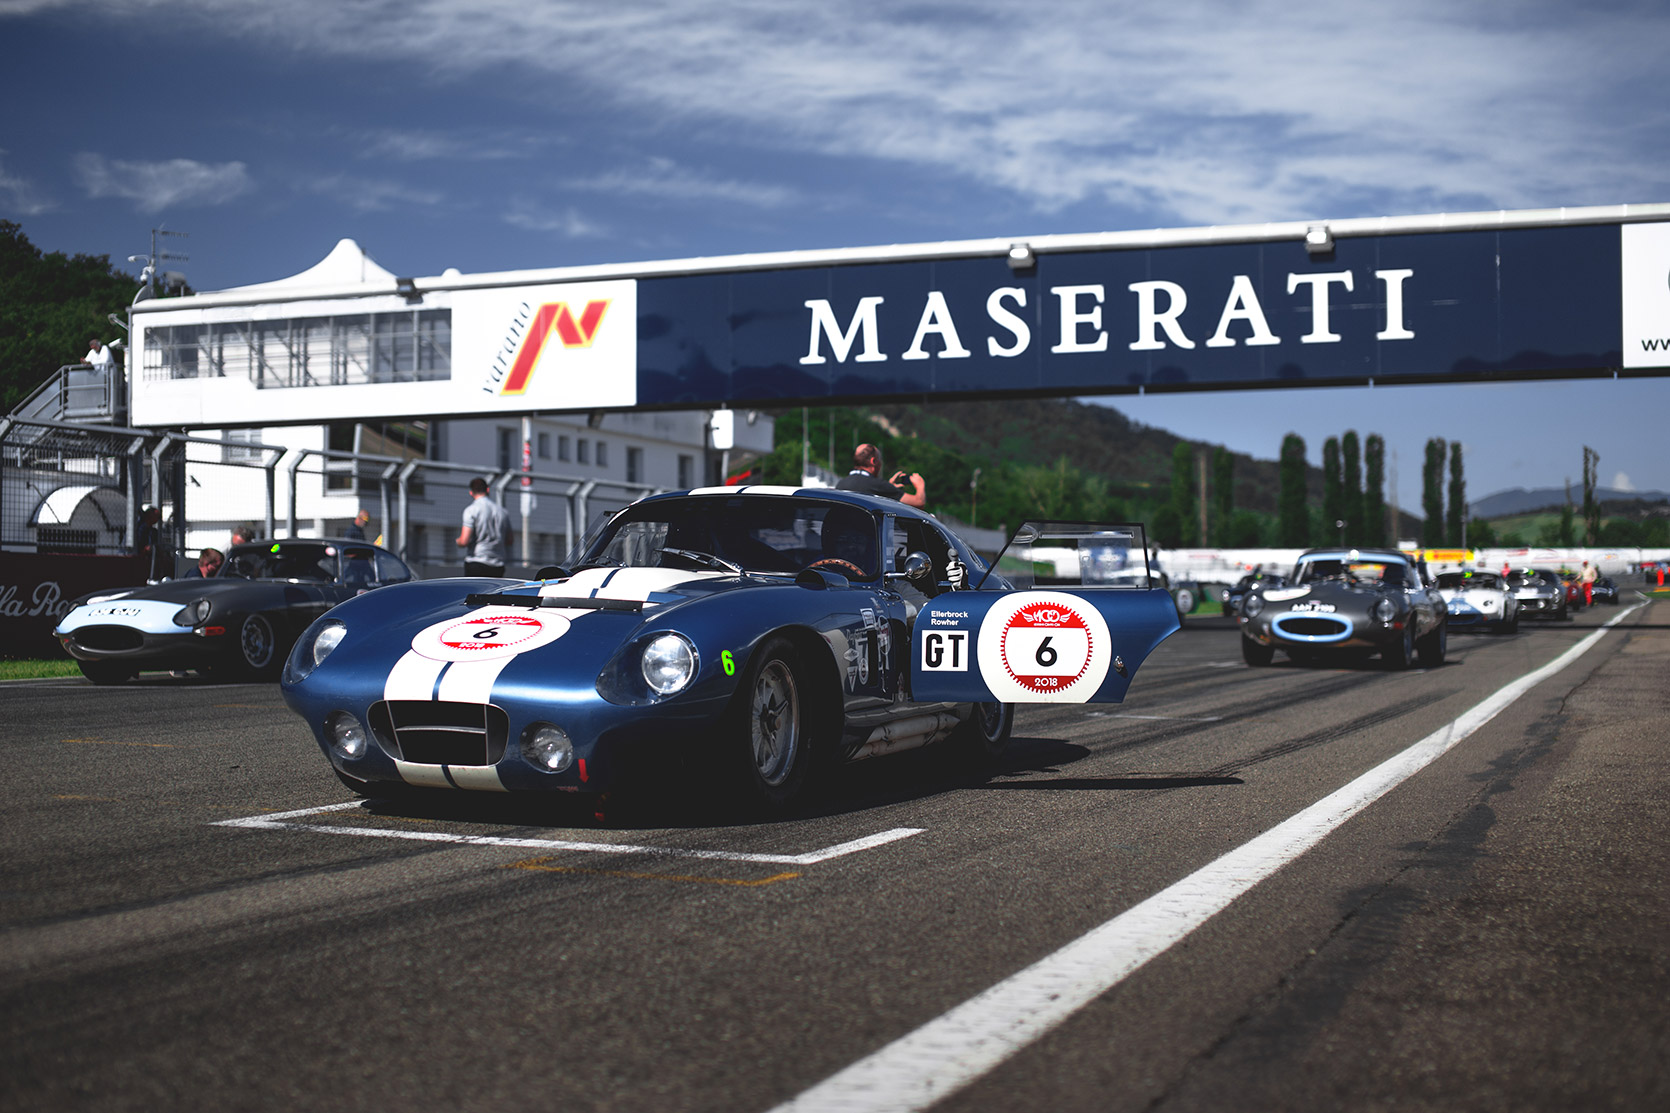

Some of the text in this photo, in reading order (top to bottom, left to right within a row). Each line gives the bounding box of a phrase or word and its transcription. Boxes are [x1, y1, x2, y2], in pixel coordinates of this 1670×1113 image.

[800, 269, 1414, 365] MASERATI
[482, 301, 530, 394] varano
[931, 610, 969, 618] Ellerbrock
[931, 618, 959, 626] Rowher
[473, 627, 500, 639] 6
[721, 649, 735, 676] 6
[925, 633, 965, 668] GT
[1035, 636, 1058, 667] 6
[1034, 677, 1058, 687] 2018
